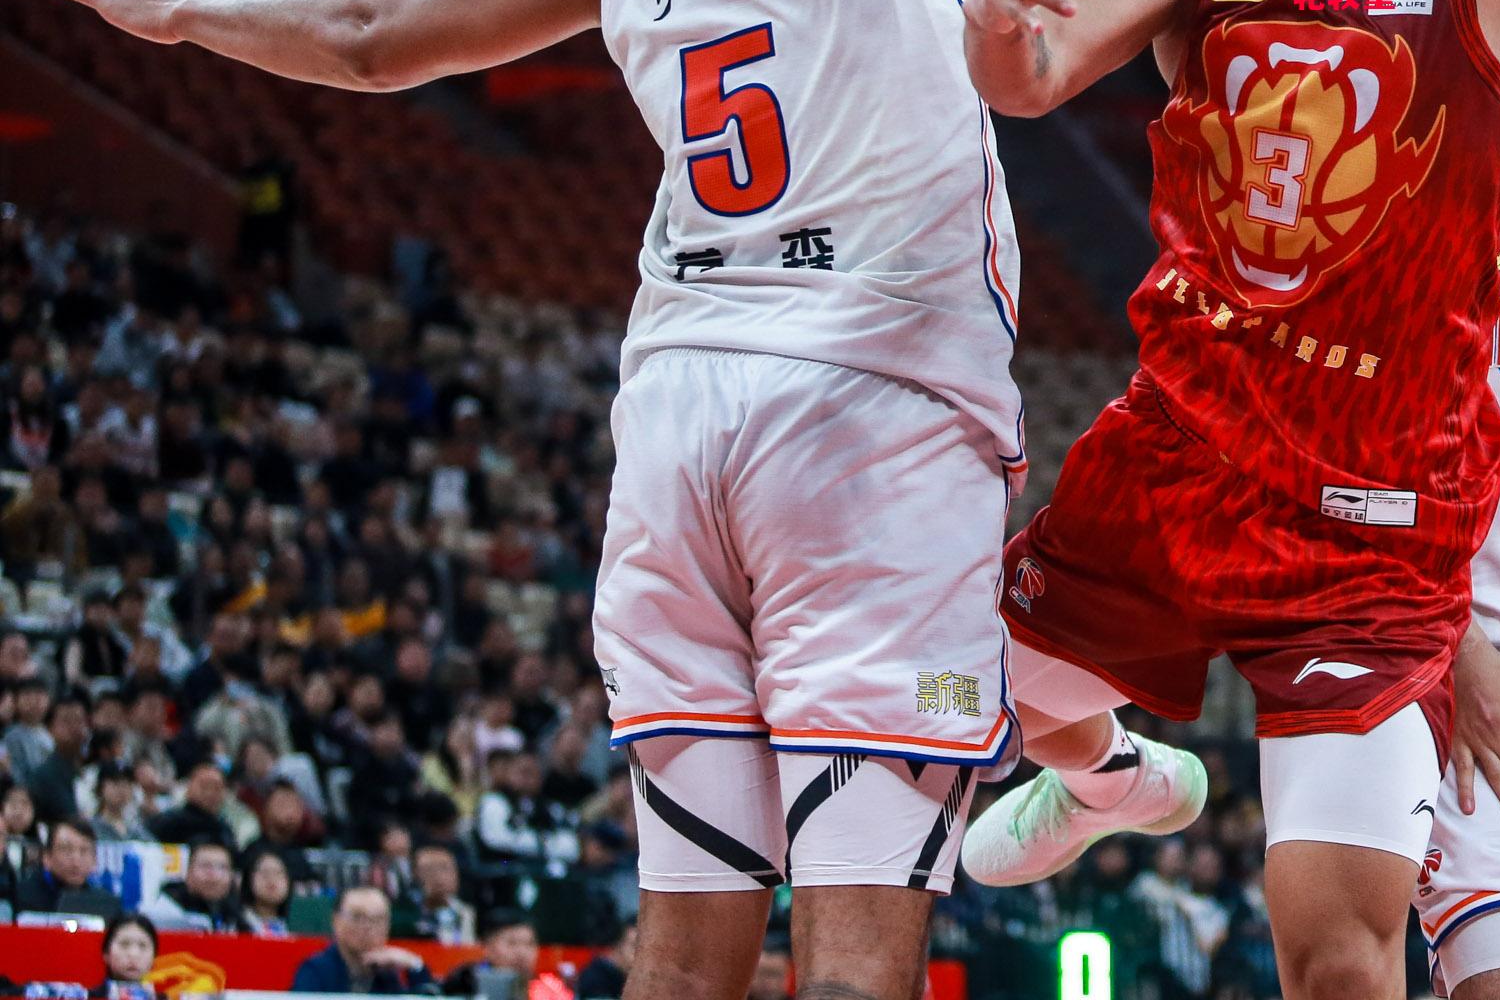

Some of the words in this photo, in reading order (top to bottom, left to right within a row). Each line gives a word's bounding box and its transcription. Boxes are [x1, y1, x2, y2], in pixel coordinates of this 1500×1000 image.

[680, 22, 791, 218] 5
[1244, 127, 1312, 232] 3
[915, 670, 981, 717] 新疆
